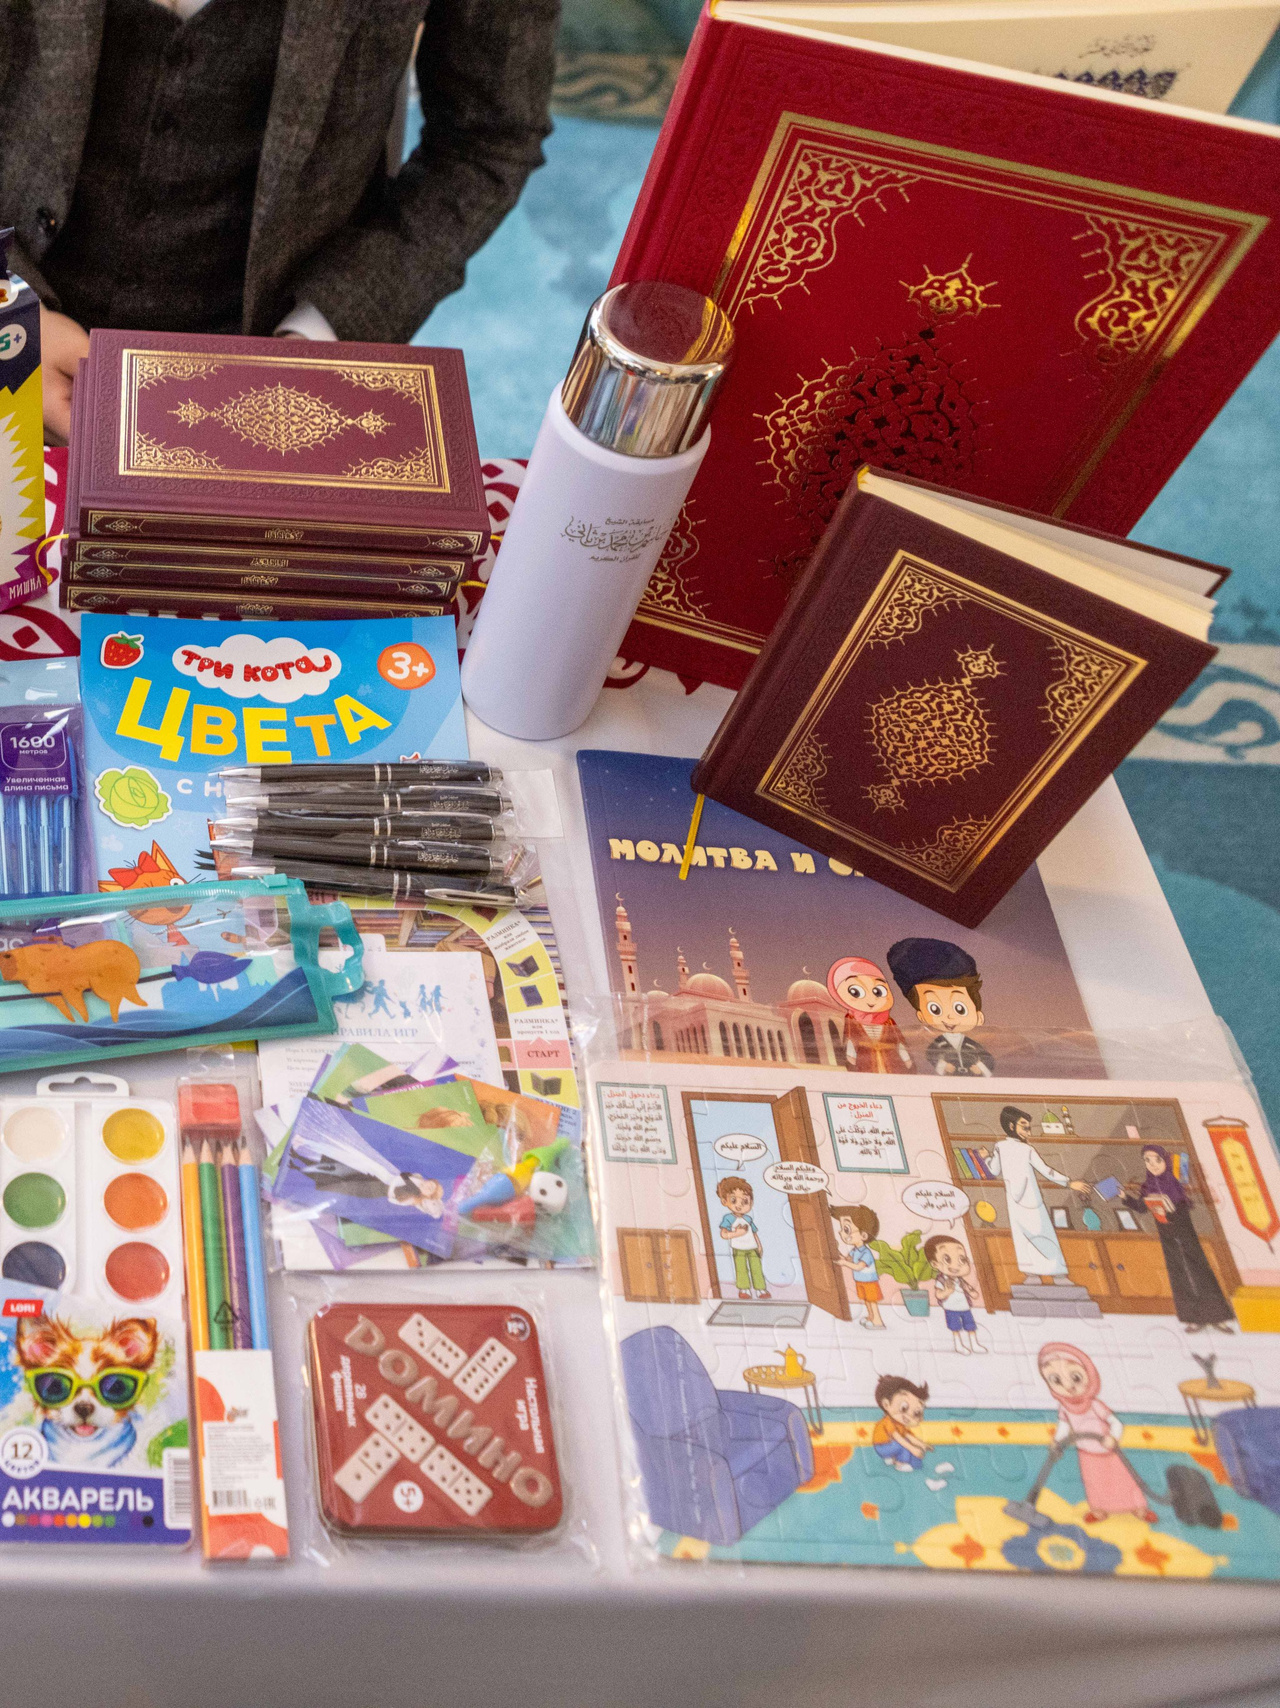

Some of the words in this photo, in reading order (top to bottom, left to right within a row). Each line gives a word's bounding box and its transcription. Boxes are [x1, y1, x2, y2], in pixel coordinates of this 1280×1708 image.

[0, 333, 23, 352] 5+
[9, 575, 42, 600] МИШКА
[387, 651, 429, 680] 3+
[116, 676, 393, 764] ЦВЕТА
[19, 748, 49, 756] метров
[6, 776, 66, 784] Увеличенная
[4, 784, 32, 792] длина
[34, 784, 69, 792] письма
[790, 852, 816, 874] И
[394, 1027, 419, 1038] ИГР
[527, 1050, 560, 1058] СТАРТ
[721, 1142, 738, 1151] عليكم
[740, 1142, 762, 1152] السلام
[775, 1164, 794, 1172] السلام
[795, 1165, 816, 1173] وعليكم
[793, 1173, 804, 1181] الله
[804, 1174, 824, 1183] ورحمة
[915, 1190, 932, 1199] عليكم
[934, 1190, 955, 1199] السلام
[10, 1303, 36, 1313] LORI
[515, 1399, 529, 1431] игра
[524, 1377, 545, 1454] Настольная
[11, 1443, 33, 1461] 12
[2, 1486, 155, 1512] АКВАРЕЛЬ
